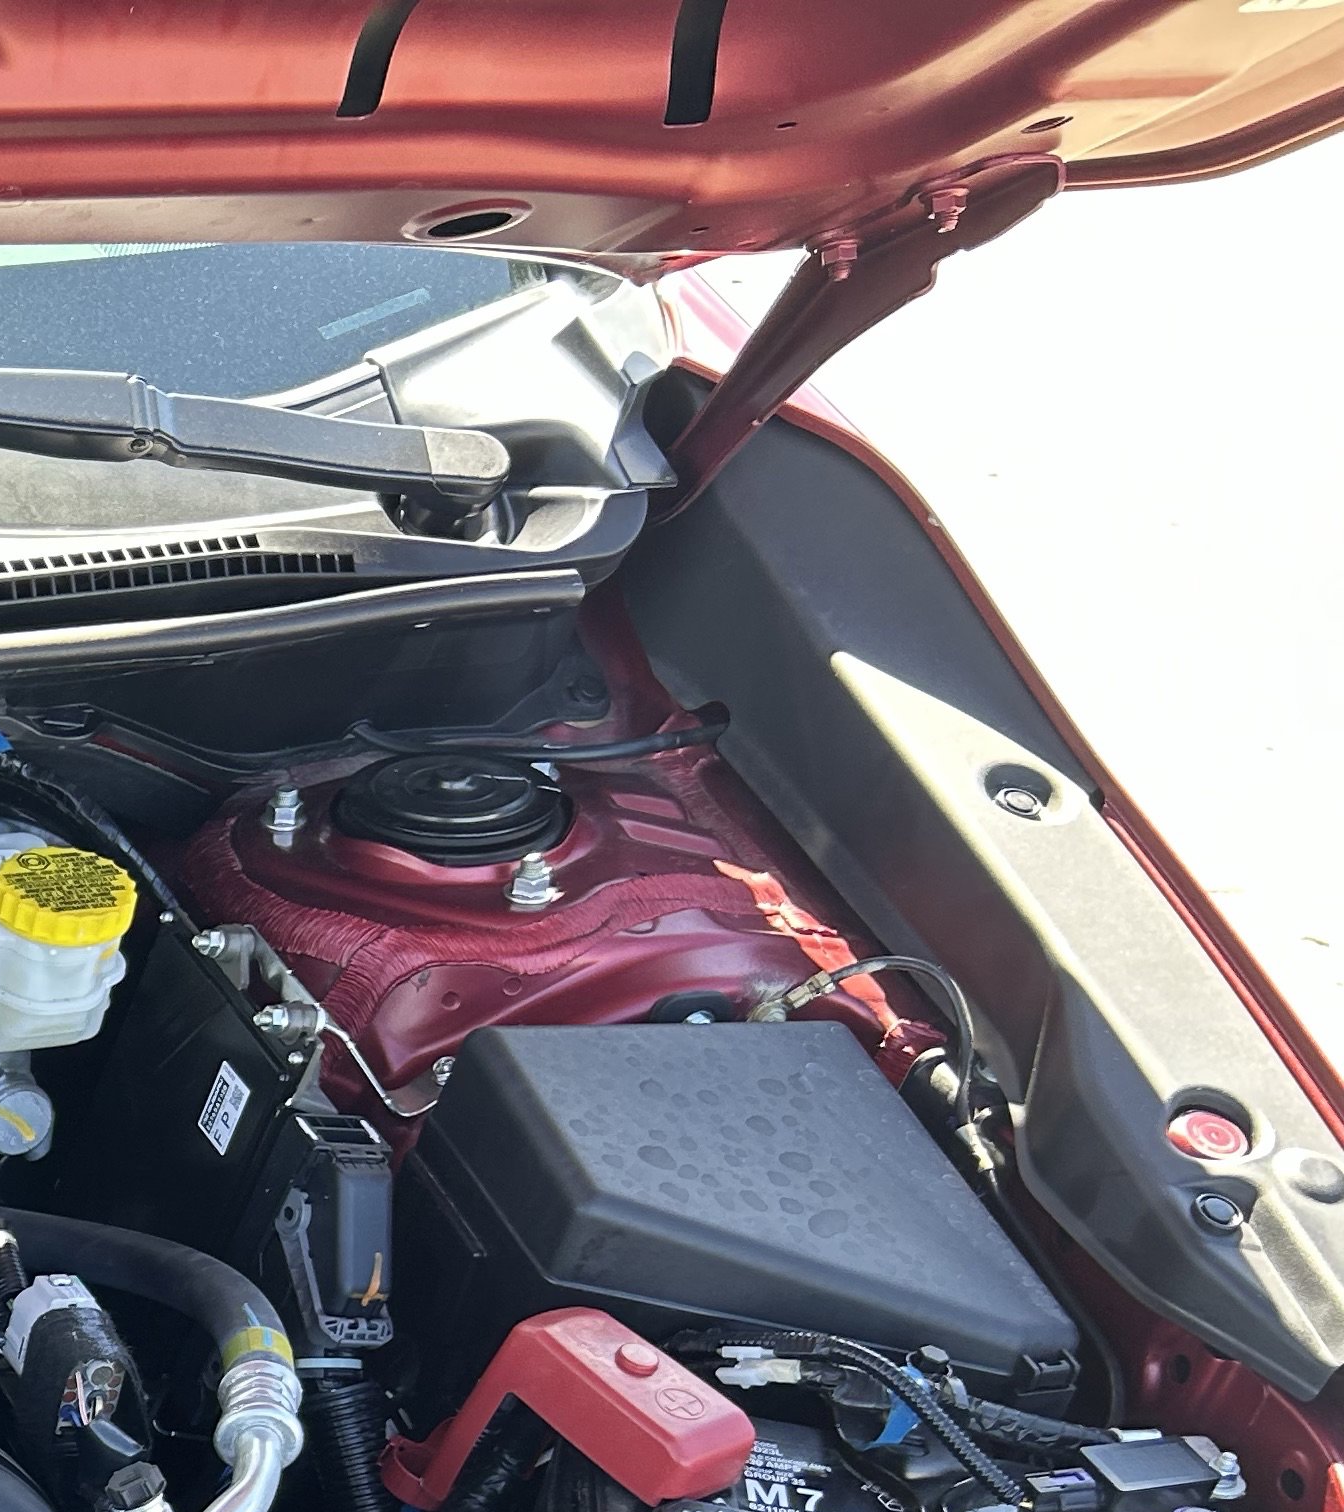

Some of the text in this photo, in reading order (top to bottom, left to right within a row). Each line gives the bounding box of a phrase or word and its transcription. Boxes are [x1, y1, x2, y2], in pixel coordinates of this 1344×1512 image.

[744, 1470, 789, 1482] GROUP
[745, 1478, 824, 1512] M 7
